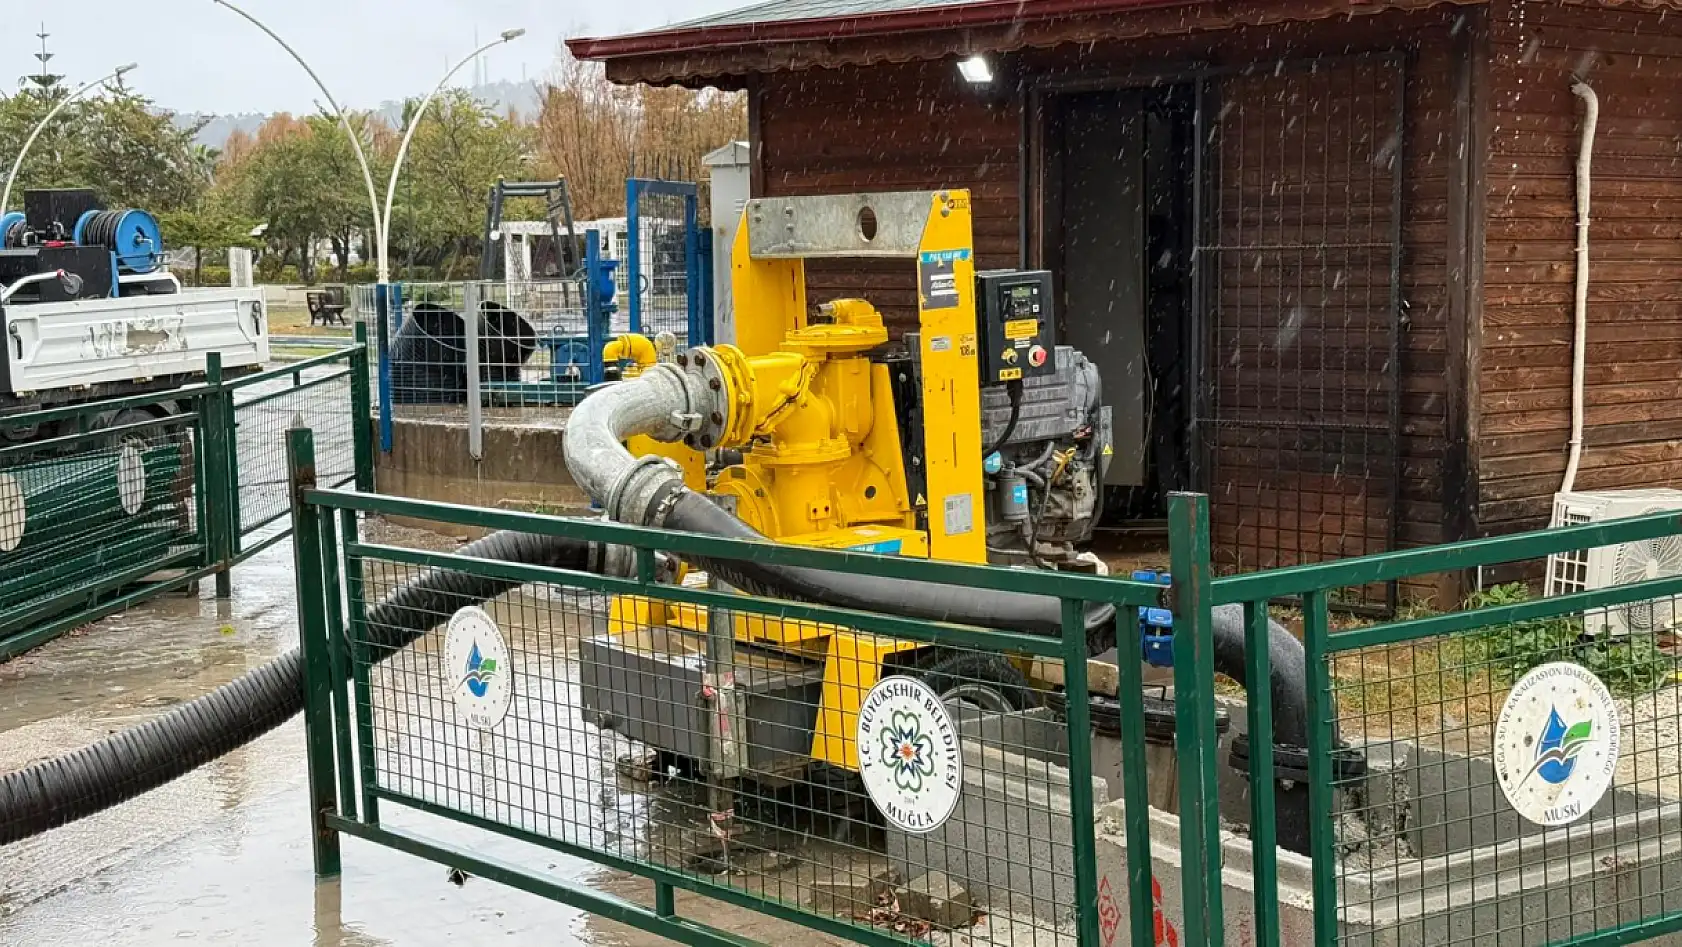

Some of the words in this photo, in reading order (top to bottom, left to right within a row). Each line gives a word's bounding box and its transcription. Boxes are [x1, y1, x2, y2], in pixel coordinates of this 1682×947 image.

[1503, 710, 1513, 724] VE
[861, 682, 922, 734] BÜYÜKŞEHİR
[923, 698, 958, 791] BELEDİYESİ
[1499, 727, 1508, 741] SU
[885, 801, 935, 827] MUĞLA
[1543, 801, 1581, 823] MUSKİ
